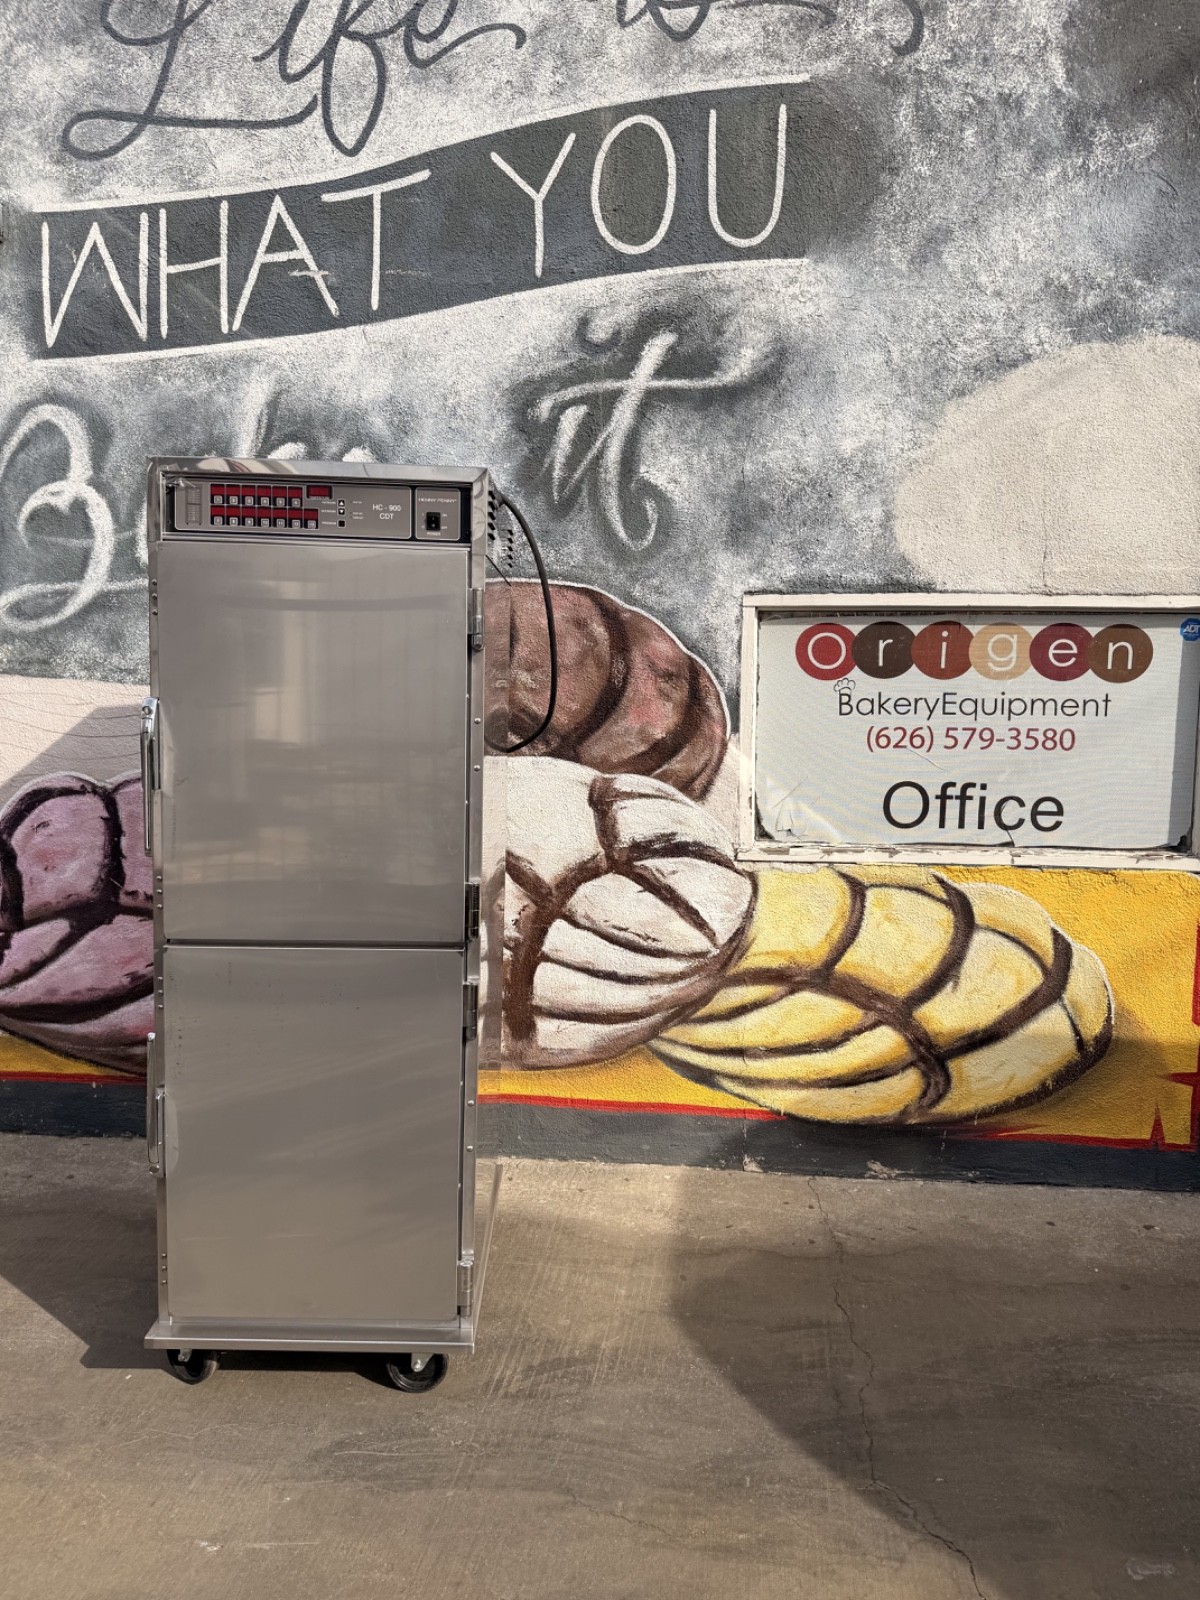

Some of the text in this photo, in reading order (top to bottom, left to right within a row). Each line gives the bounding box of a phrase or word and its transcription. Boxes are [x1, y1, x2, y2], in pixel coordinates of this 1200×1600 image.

[41, 104, 787, 348] WHAT YOU
[379, 512, 394, 520] CDT
[865, 725, 1077, 753] (626) 579-3580
[882, 780, 1064, 833] Office
